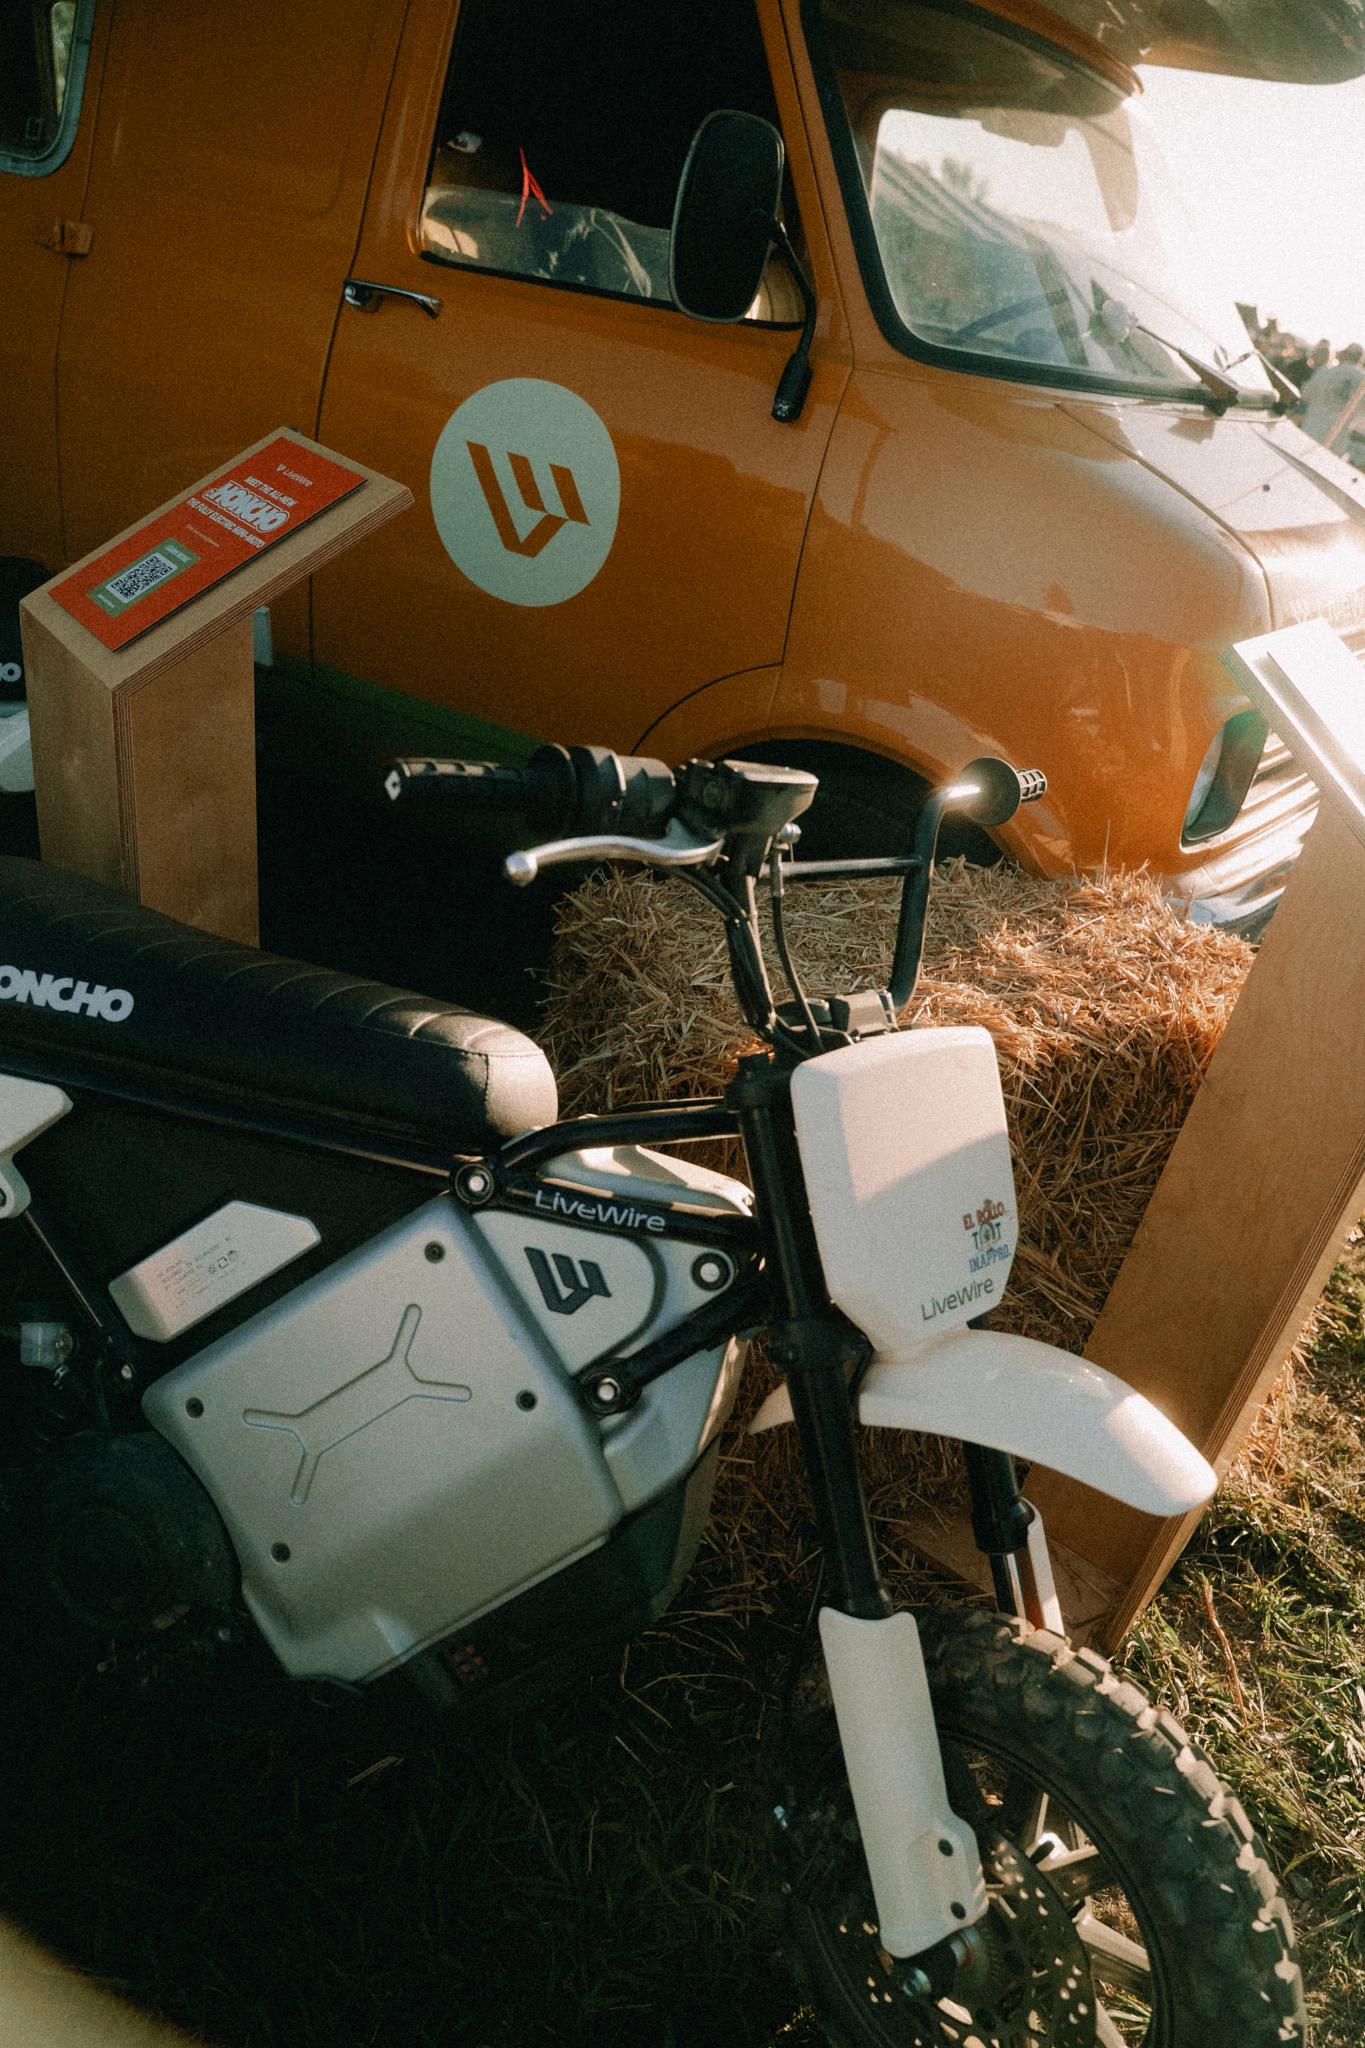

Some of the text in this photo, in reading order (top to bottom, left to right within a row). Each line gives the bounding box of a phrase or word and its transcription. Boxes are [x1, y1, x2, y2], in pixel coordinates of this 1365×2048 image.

[209, 480, 289, 532] HONCHO
[535, 1190, 665, 1231] LiveWire
[921, 1278, 993, 1320] LiveWire
